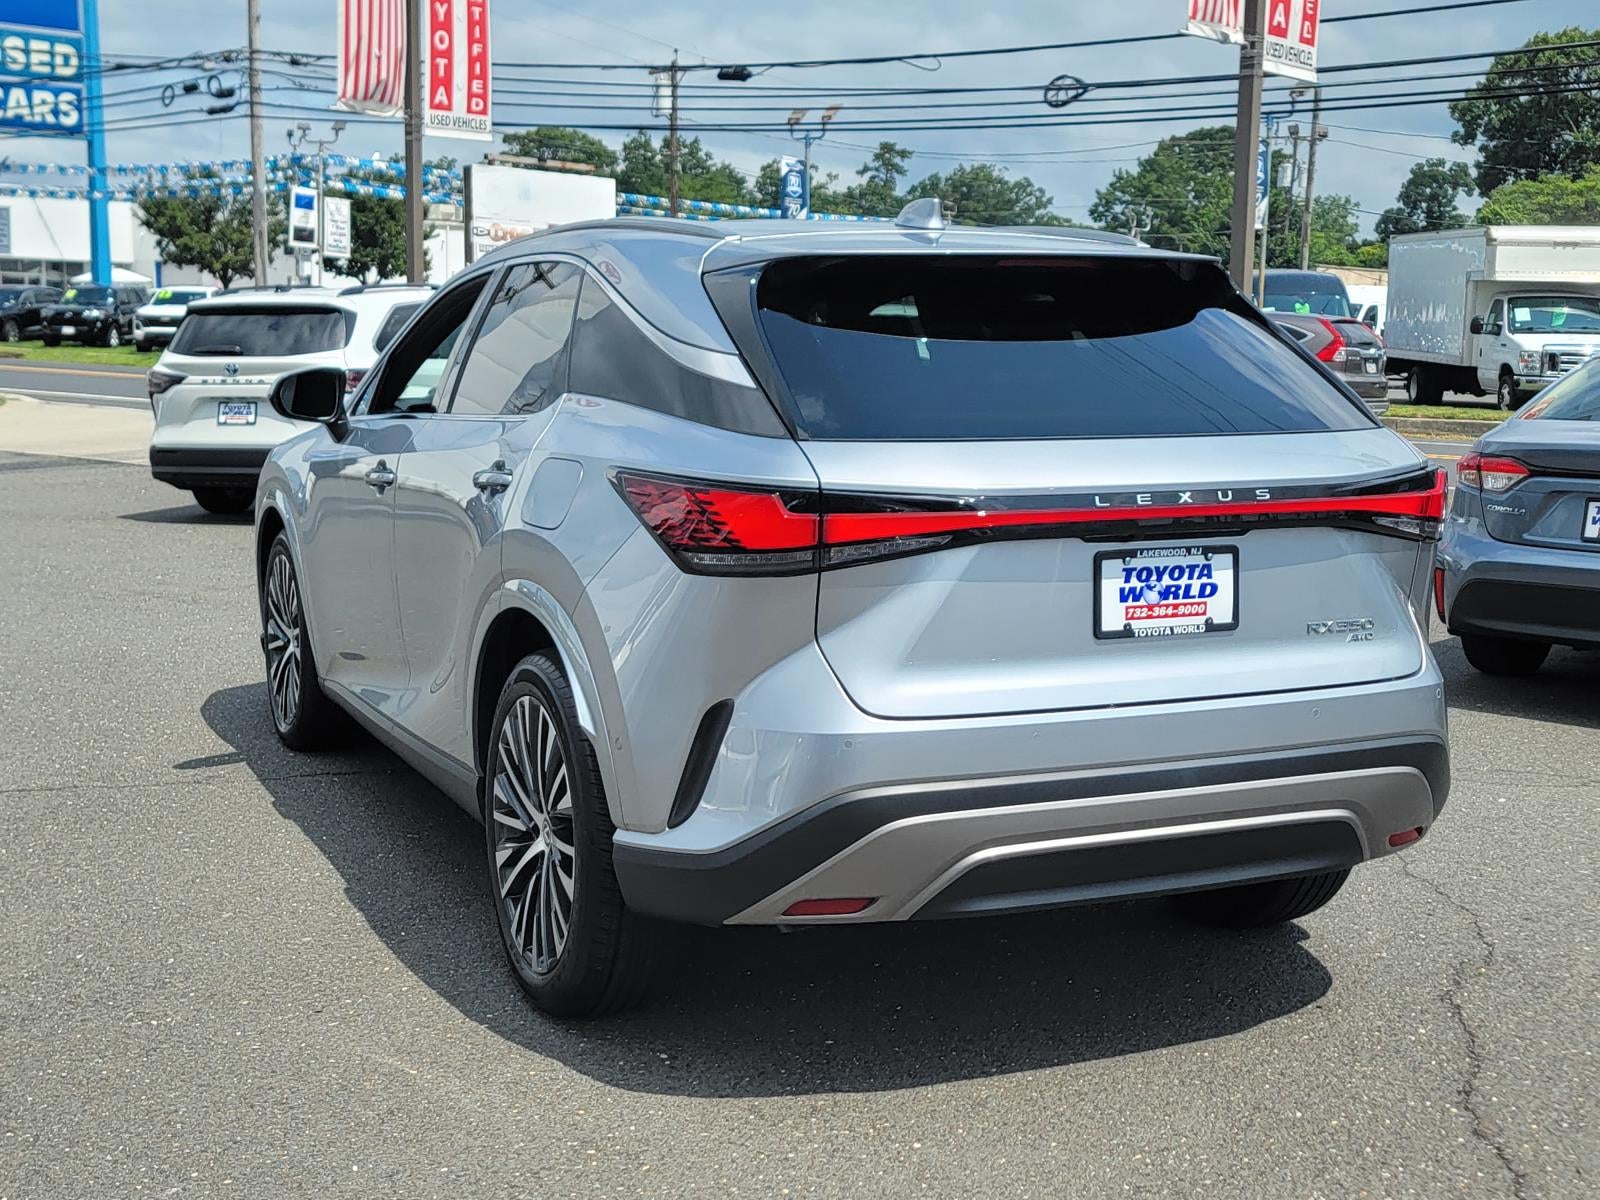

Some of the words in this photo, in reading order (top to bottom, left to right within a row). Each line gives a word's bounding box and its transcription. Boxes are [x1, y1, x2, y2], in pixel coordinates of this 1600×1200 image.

[0, 35, 79, 77] SED
[471, 0, 485, 111] TIFIED
[0, 86, 80, 128] ARS
[430, 113, 451, 126] USED
[452, 115, 488, 130] VEHICLES
[1094, 488, 1271, 508] LEXUS
[1136, 549, 1189, 558] LAKEWOOD,
[1190, 547, 1203, 556] NJ
[1121, 563, 1213, 584] TOYOTA
[1119, 581, 1219, 604] WORLD
[1126, 603, 1206, 619] 732-364-9000
[1133, 627, 1172, 637] TOYOTA
[1173, 624, 1206, 634] WORLD
